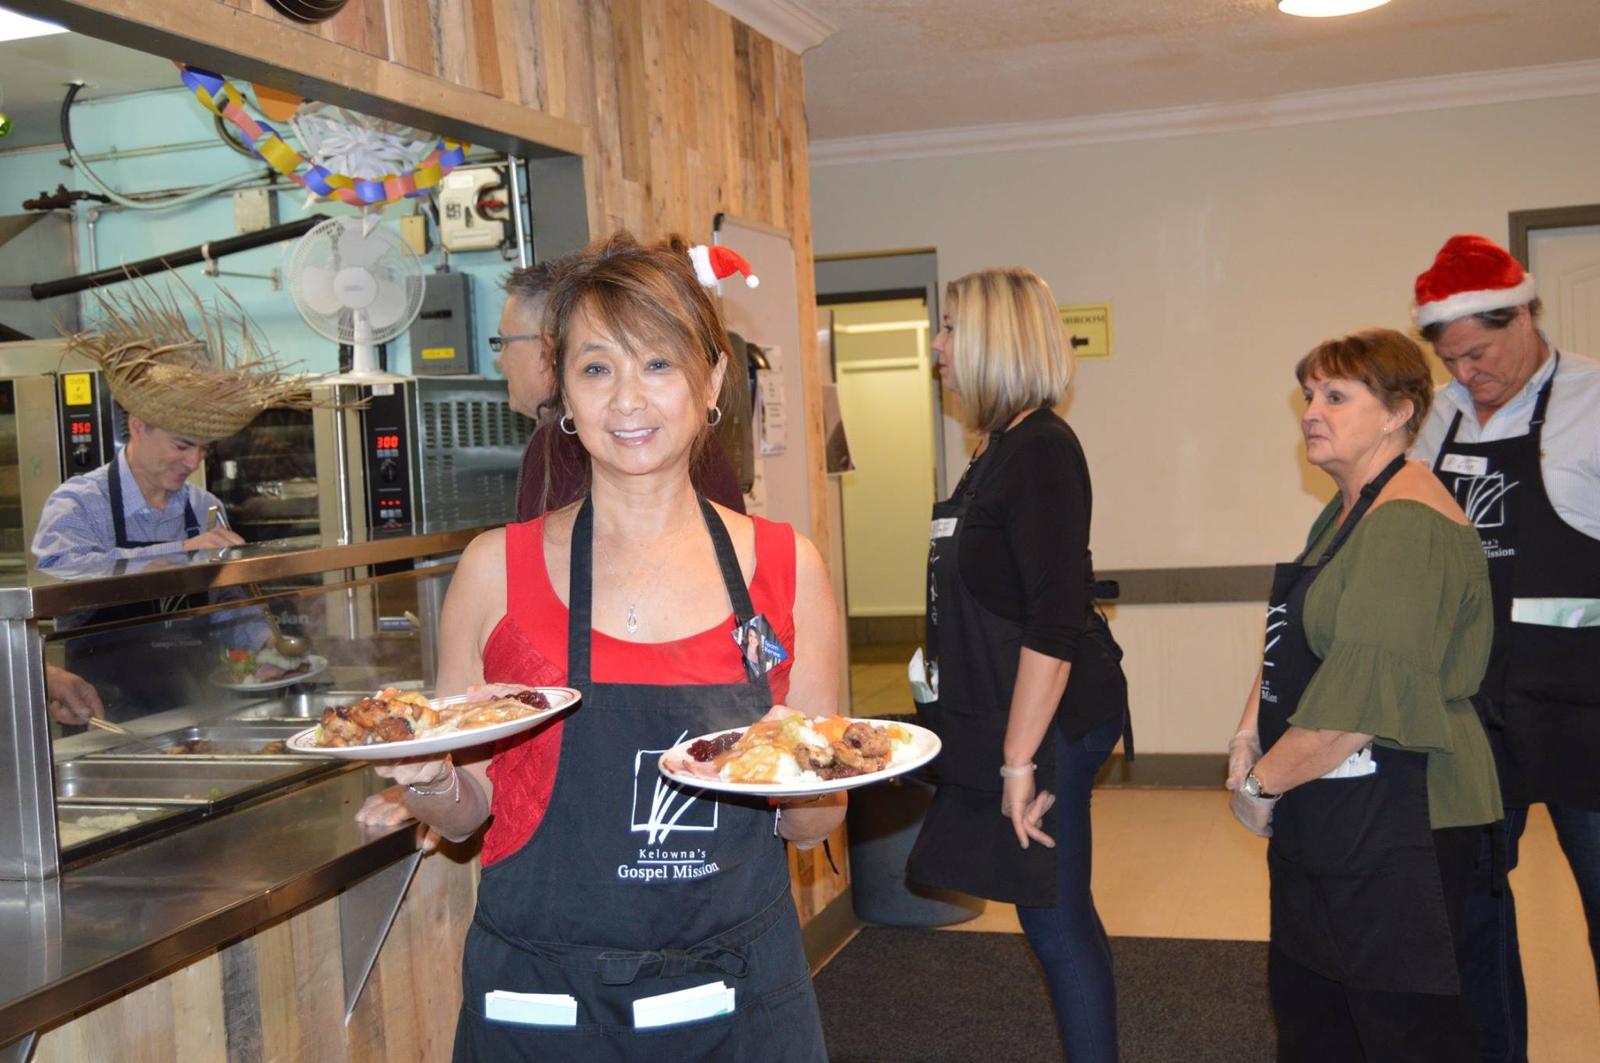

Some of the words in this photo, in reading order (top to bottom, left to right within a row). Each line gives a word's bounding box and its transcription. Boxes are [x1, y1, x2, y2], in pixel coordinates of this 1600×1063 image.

[71, 422, 92, 434] 350
[376, 435, 399, 449] 300
[639, 848, 707, 859] Kelowna's
[617, 864, 668, 882] Gospel
[673, 861, 720, 879] Mission
